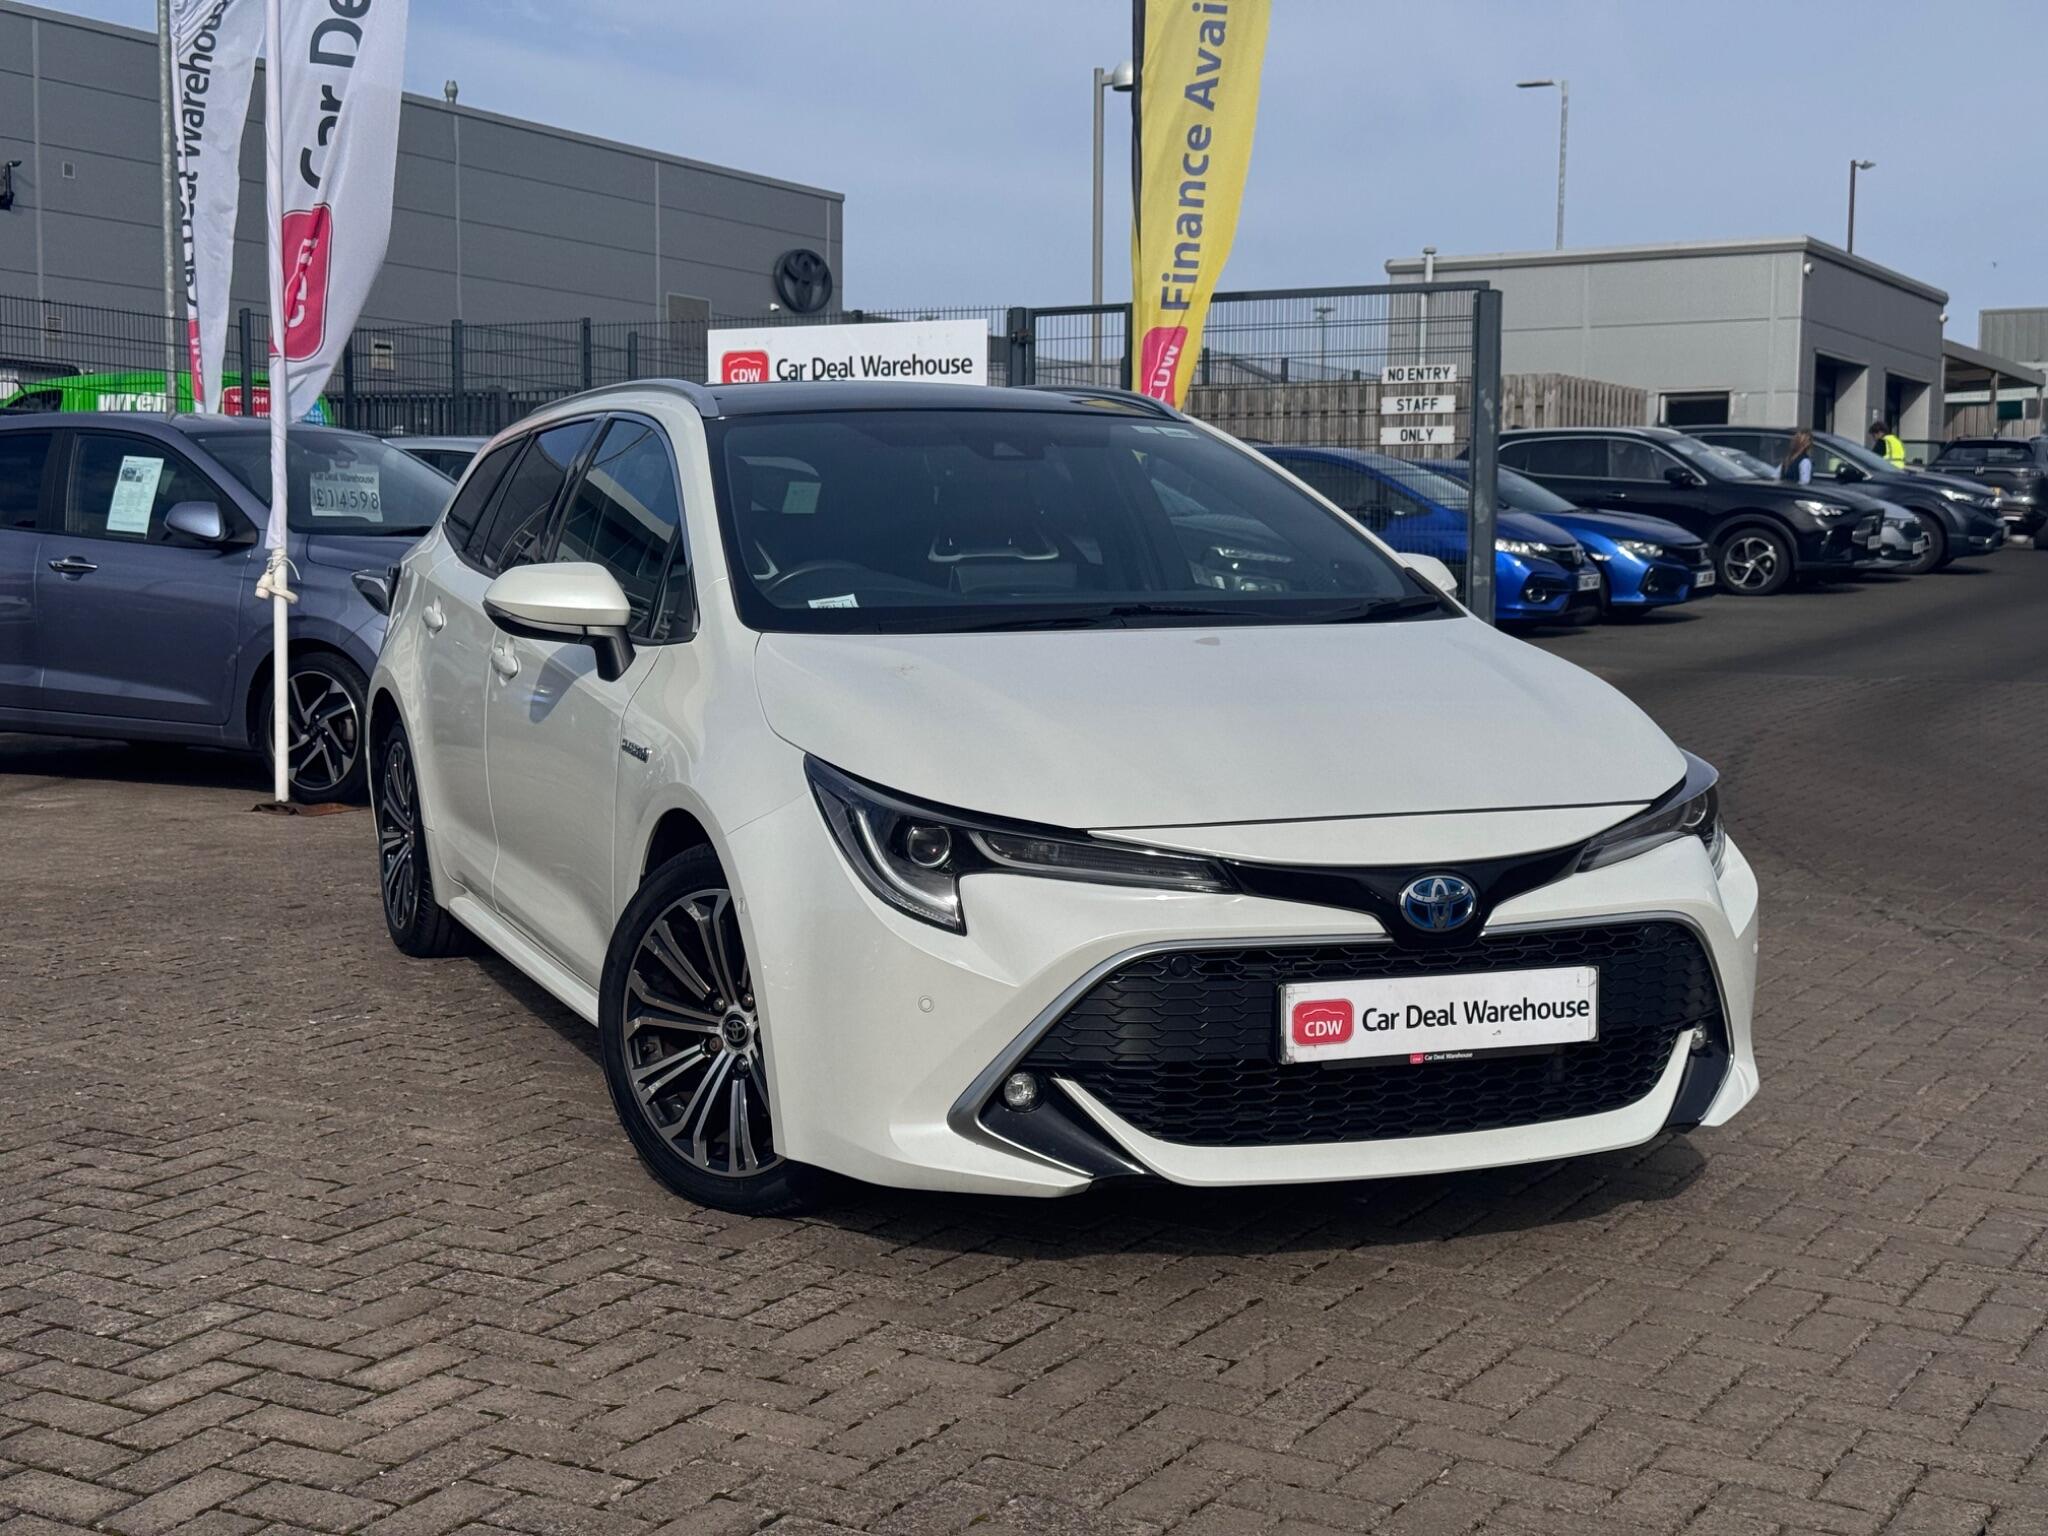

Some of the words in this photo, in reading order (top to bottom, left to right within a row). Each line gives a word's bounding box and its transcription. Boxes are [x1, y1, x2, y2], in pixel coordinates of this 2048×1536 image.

[1160, 124, 1212, 310] Finance
[730, 368, 761, 383] CDW
[776, 358, 807, 381] Car
[812, 355, 855, 380] Deal
[861, 353, 973, 377] Warehouse
[1387, 367, 1405, 381] NO
[1407, 366, 1450, 381] ENTRY
[1396, 397, 1439, 412] STAFF
[1400, 428, 1434, 442] ONLY
[316, 488, 379, 510] £14598
[1362, 1007, 1400, 1032] Car
[1405, 1001, 1457, 1029] Deal
[1463, 996, 1590, 1024] Warehouse
[1304, 1019, 1343, 1038] CDW
